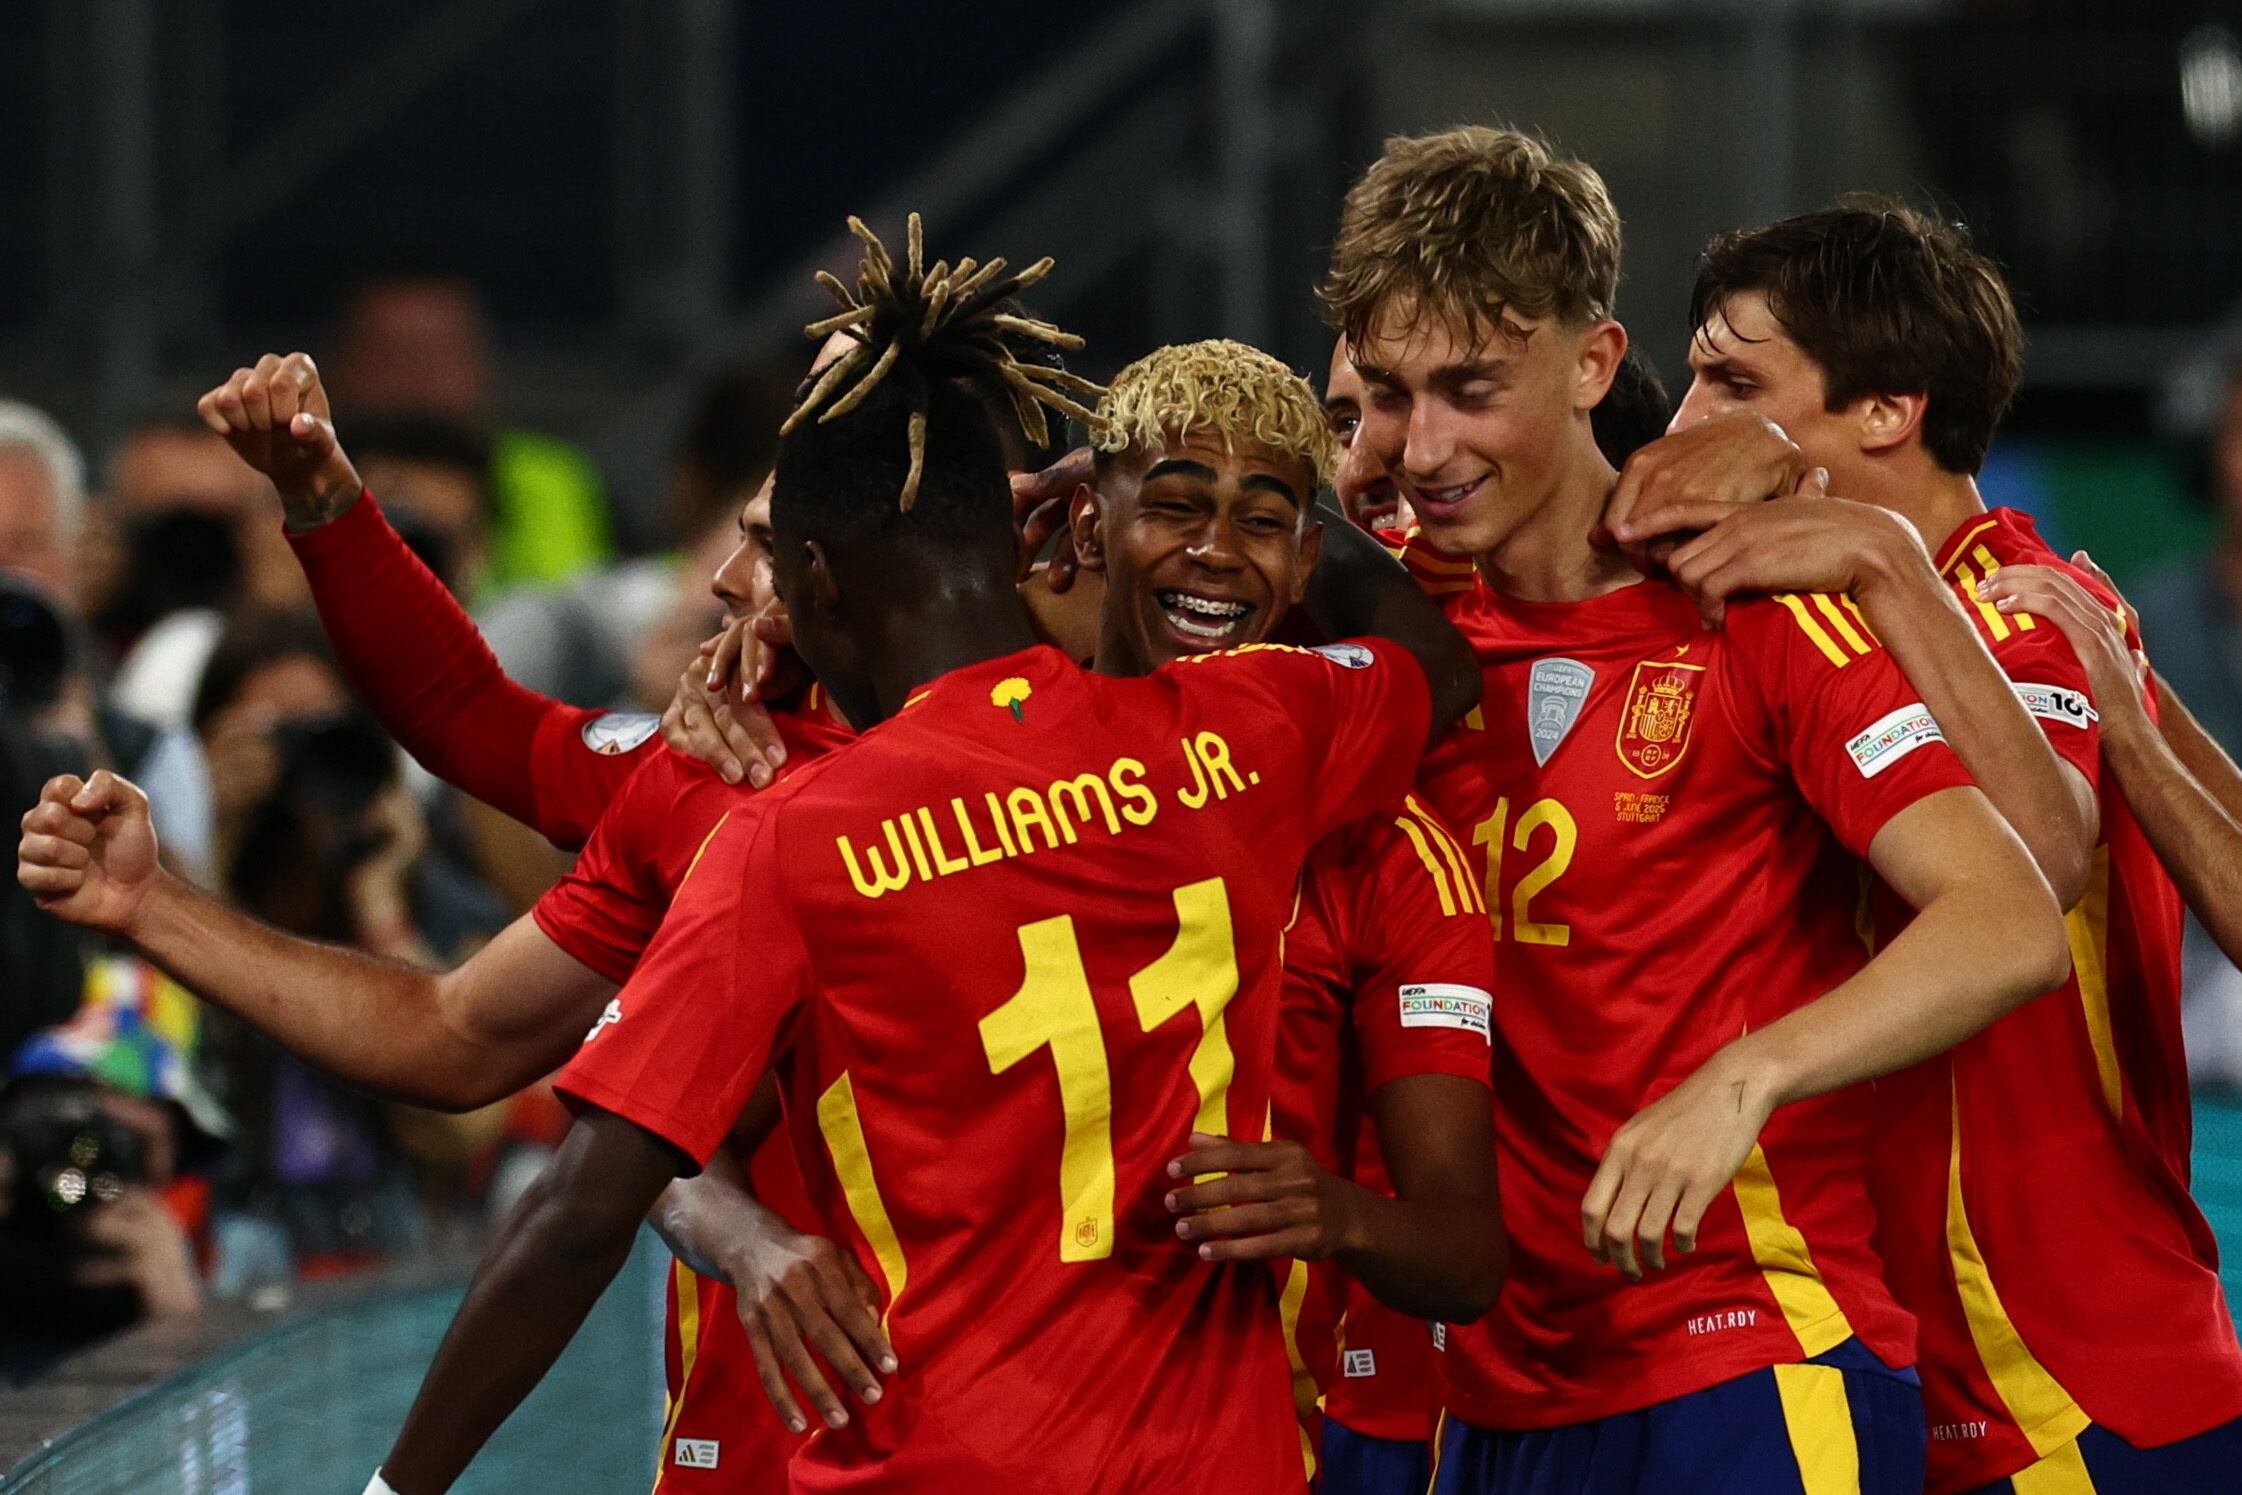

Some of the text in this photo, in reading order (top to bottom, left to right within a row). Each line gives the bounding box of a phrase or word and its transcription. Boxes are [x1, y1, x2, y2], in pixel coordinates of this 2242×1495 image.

[1534, 682, 1583, 698] CHAMPIONS
[1536, 672, 1586, 688] EUROPEAN
[1535, 728, 1560, 740] 2024
[836, 731, 1261, 898] WILLIAMS JR.
[1472, 797, 1578, 947] 12
[1403, 1000, 1487, 1017] FOUNDATION
[978, 876, 1240, 1262] 11
[1688, 1310, 1756, 1336] HEAT.RDY
